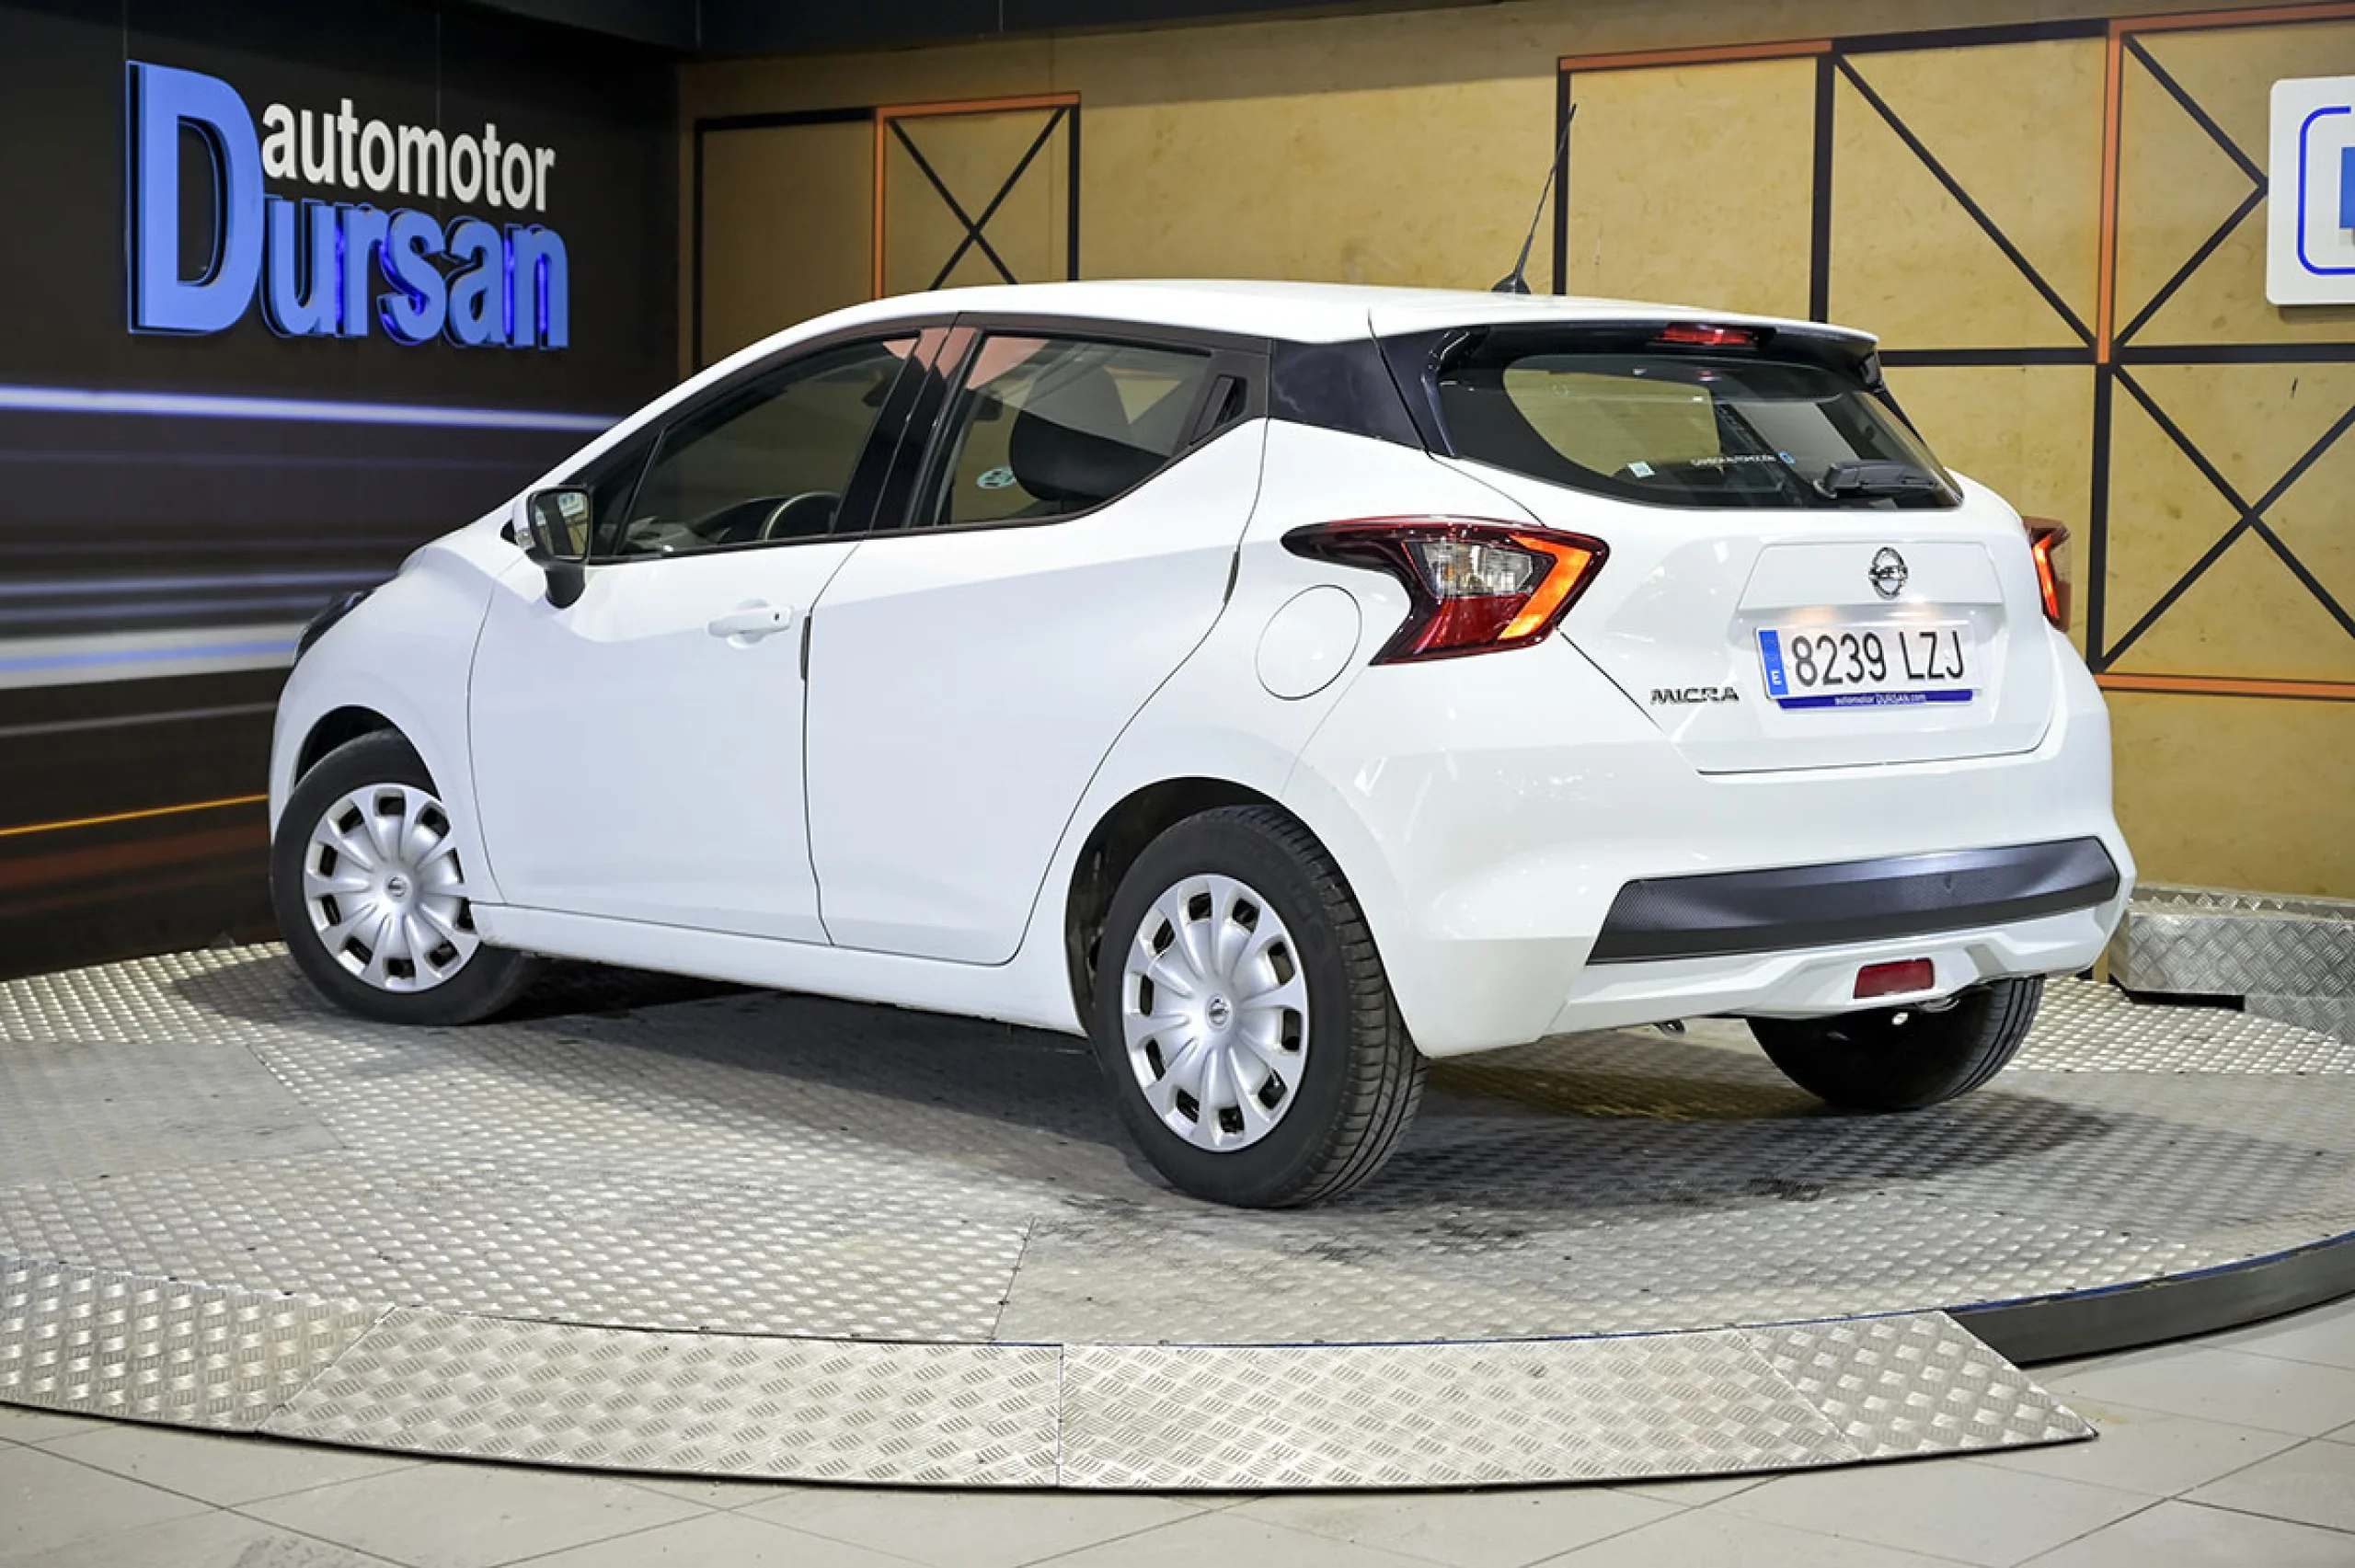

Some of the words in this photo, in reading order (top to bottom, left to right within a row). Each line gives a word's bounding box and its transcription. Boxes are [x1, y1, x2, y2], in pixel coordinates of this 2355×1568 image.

[261, 97, 557, 212] automotor
[125, 59, 569, 349] Dursan
[1770, 670, 1783, 687] E
[1790, 631, 1887, 688] 8239
[1898, 629, 1965, 681] LZJ
[1649, 686, 1740, 705] MICRA
